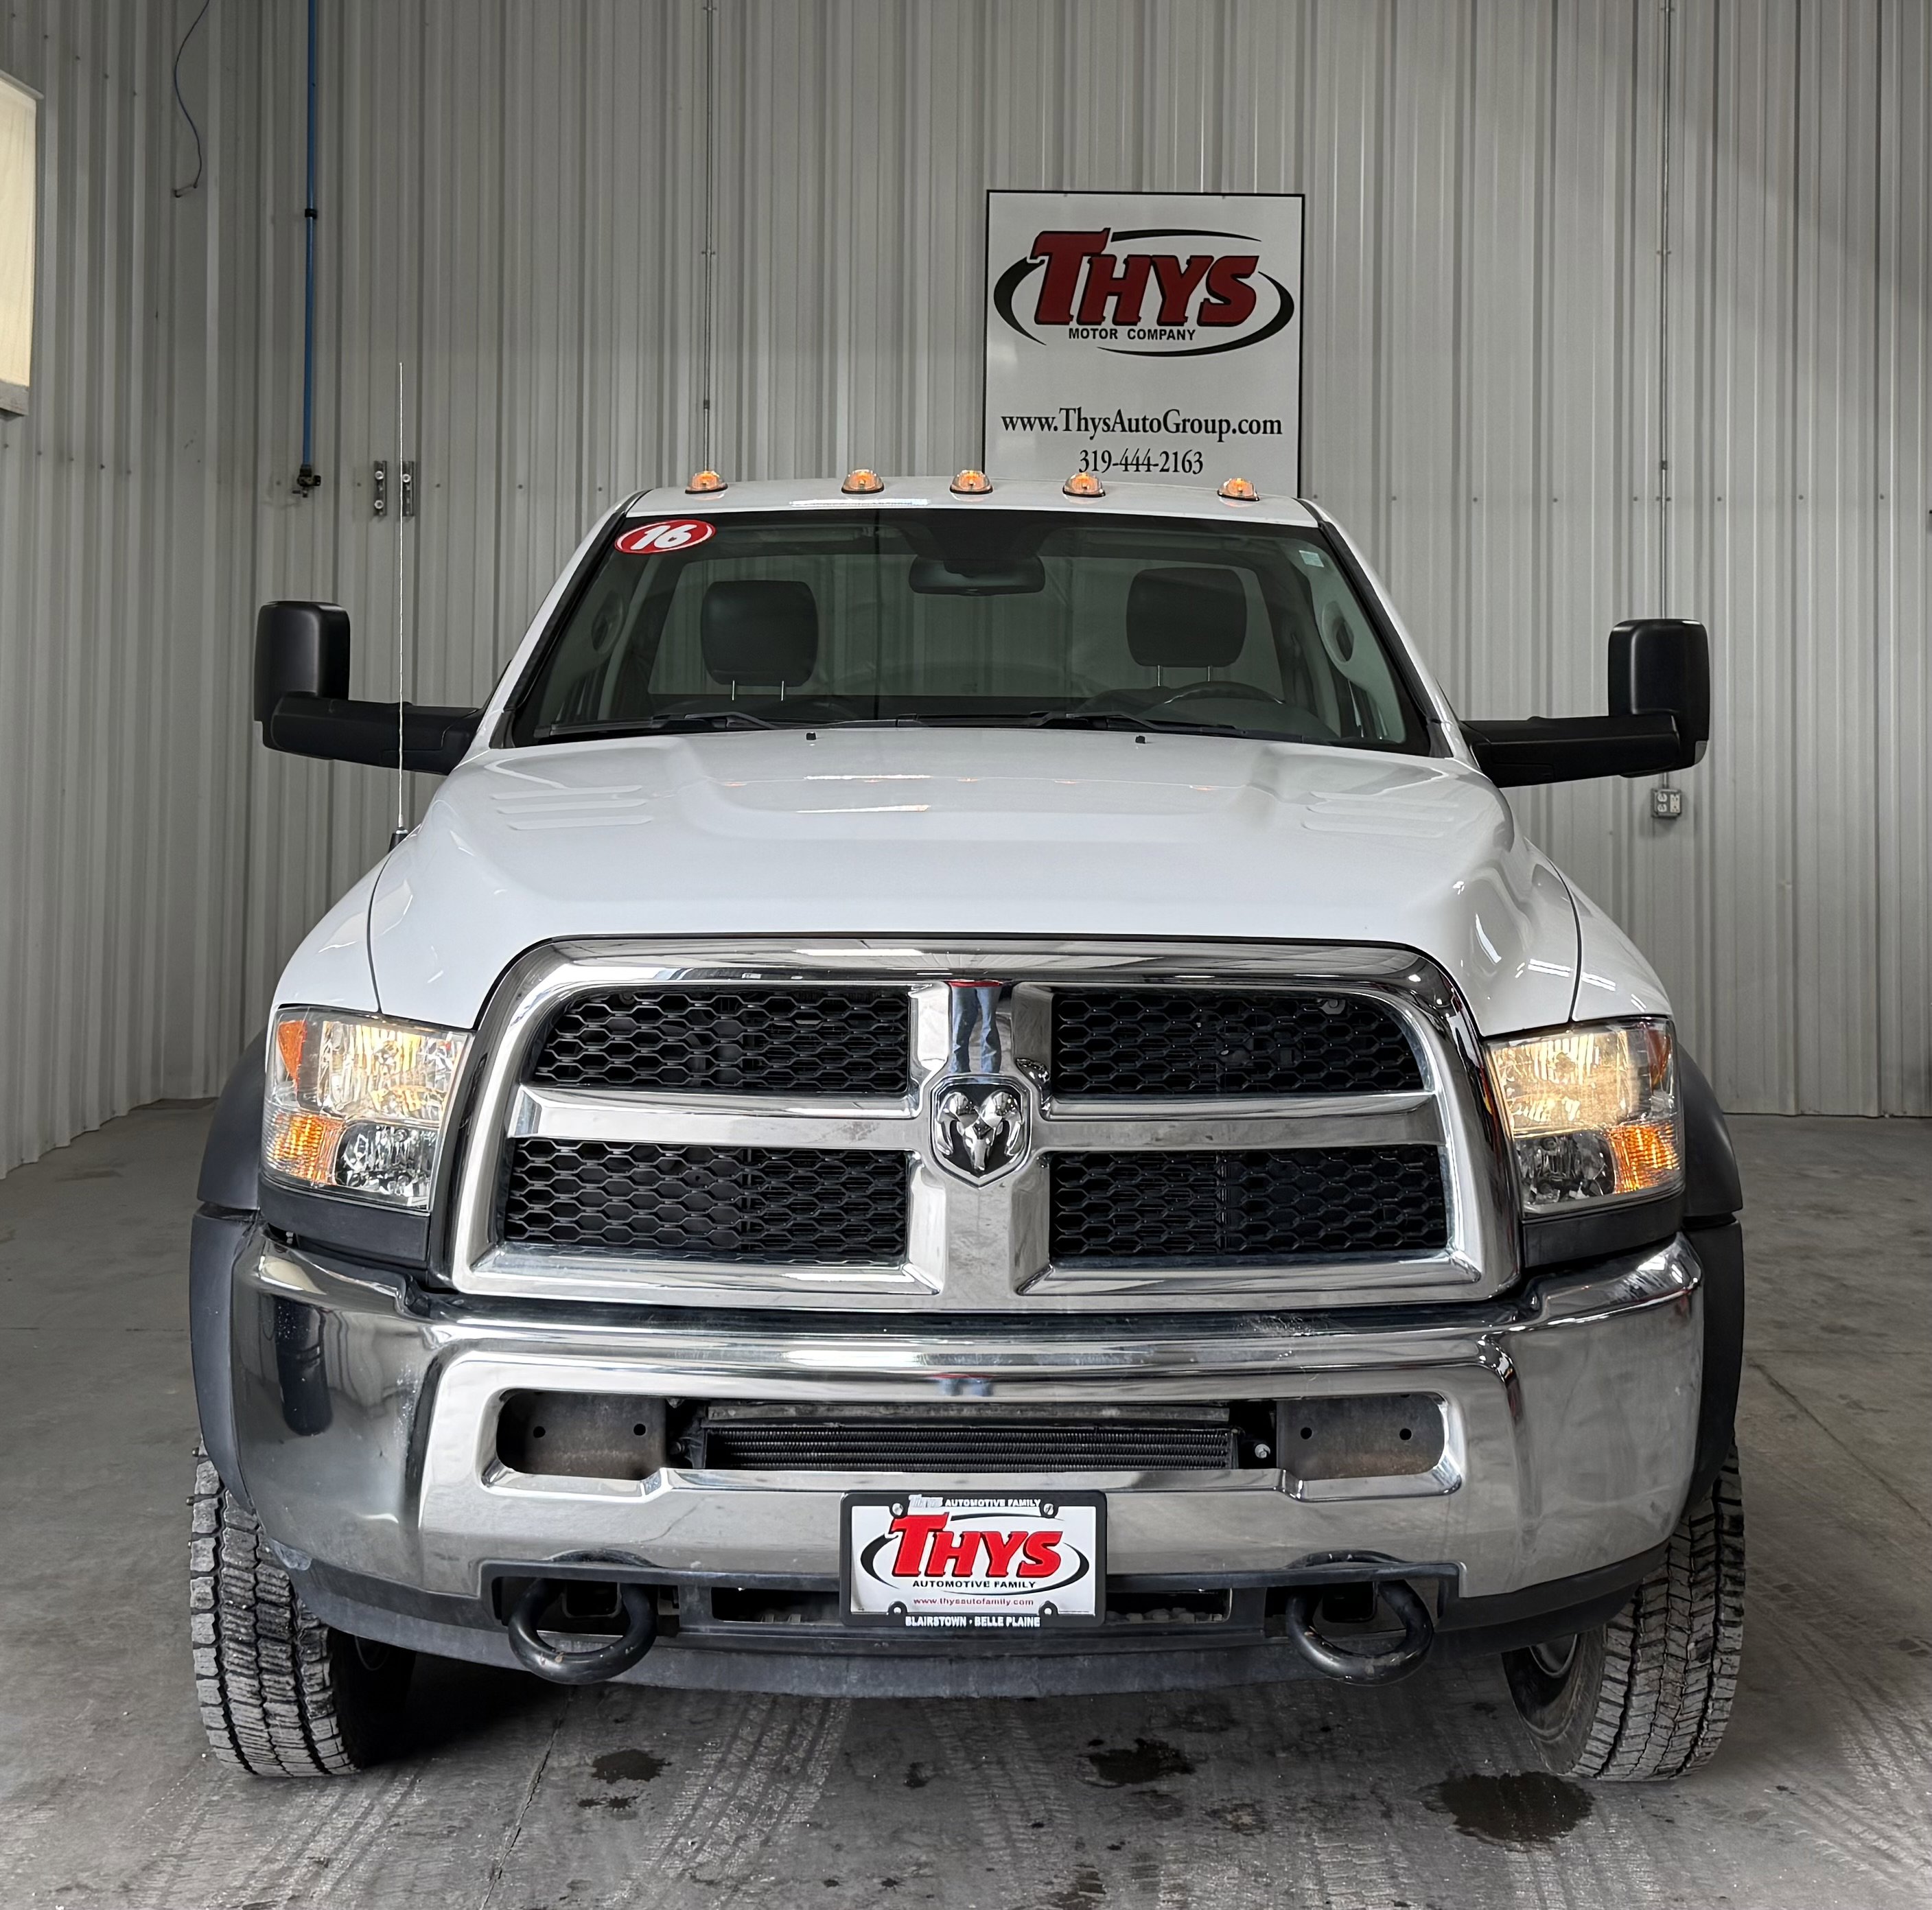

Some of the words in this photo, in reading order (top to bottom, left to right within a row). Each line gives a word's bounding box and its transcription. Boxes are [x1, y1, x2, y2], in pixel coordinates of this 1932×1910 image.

[1028, 227, 1260, 327] THYS
[1069, 327, 1118, 340] MOTOR
[1127, 328, 1196, 341] COMPANY
[1001, 406, 1283, 443] www.ThysAutoGroup.com
[1078, 447, 1204, 475] 319-444-2163
[629, 524, 698, 550] 16
[944, 1499, 1005, 1507] AUTOMOTIVE
[1008, 1499, 1041, 1507] FAMILY
[888, 1511, 1064, 1579] THYS
[912, 1580, 990, 1588] AUTOMOTIVE
[994, 1581, 1036, 1589] FAMILY
[913, 1597, 1034, 1607] www.thysautofamily.com
[905, 1616, 967, 1627] BLAIRSTOWN
[974, 1616, 1004, 1627] BELLE
[1005, 1616, 1041, 1628] PLAINE
